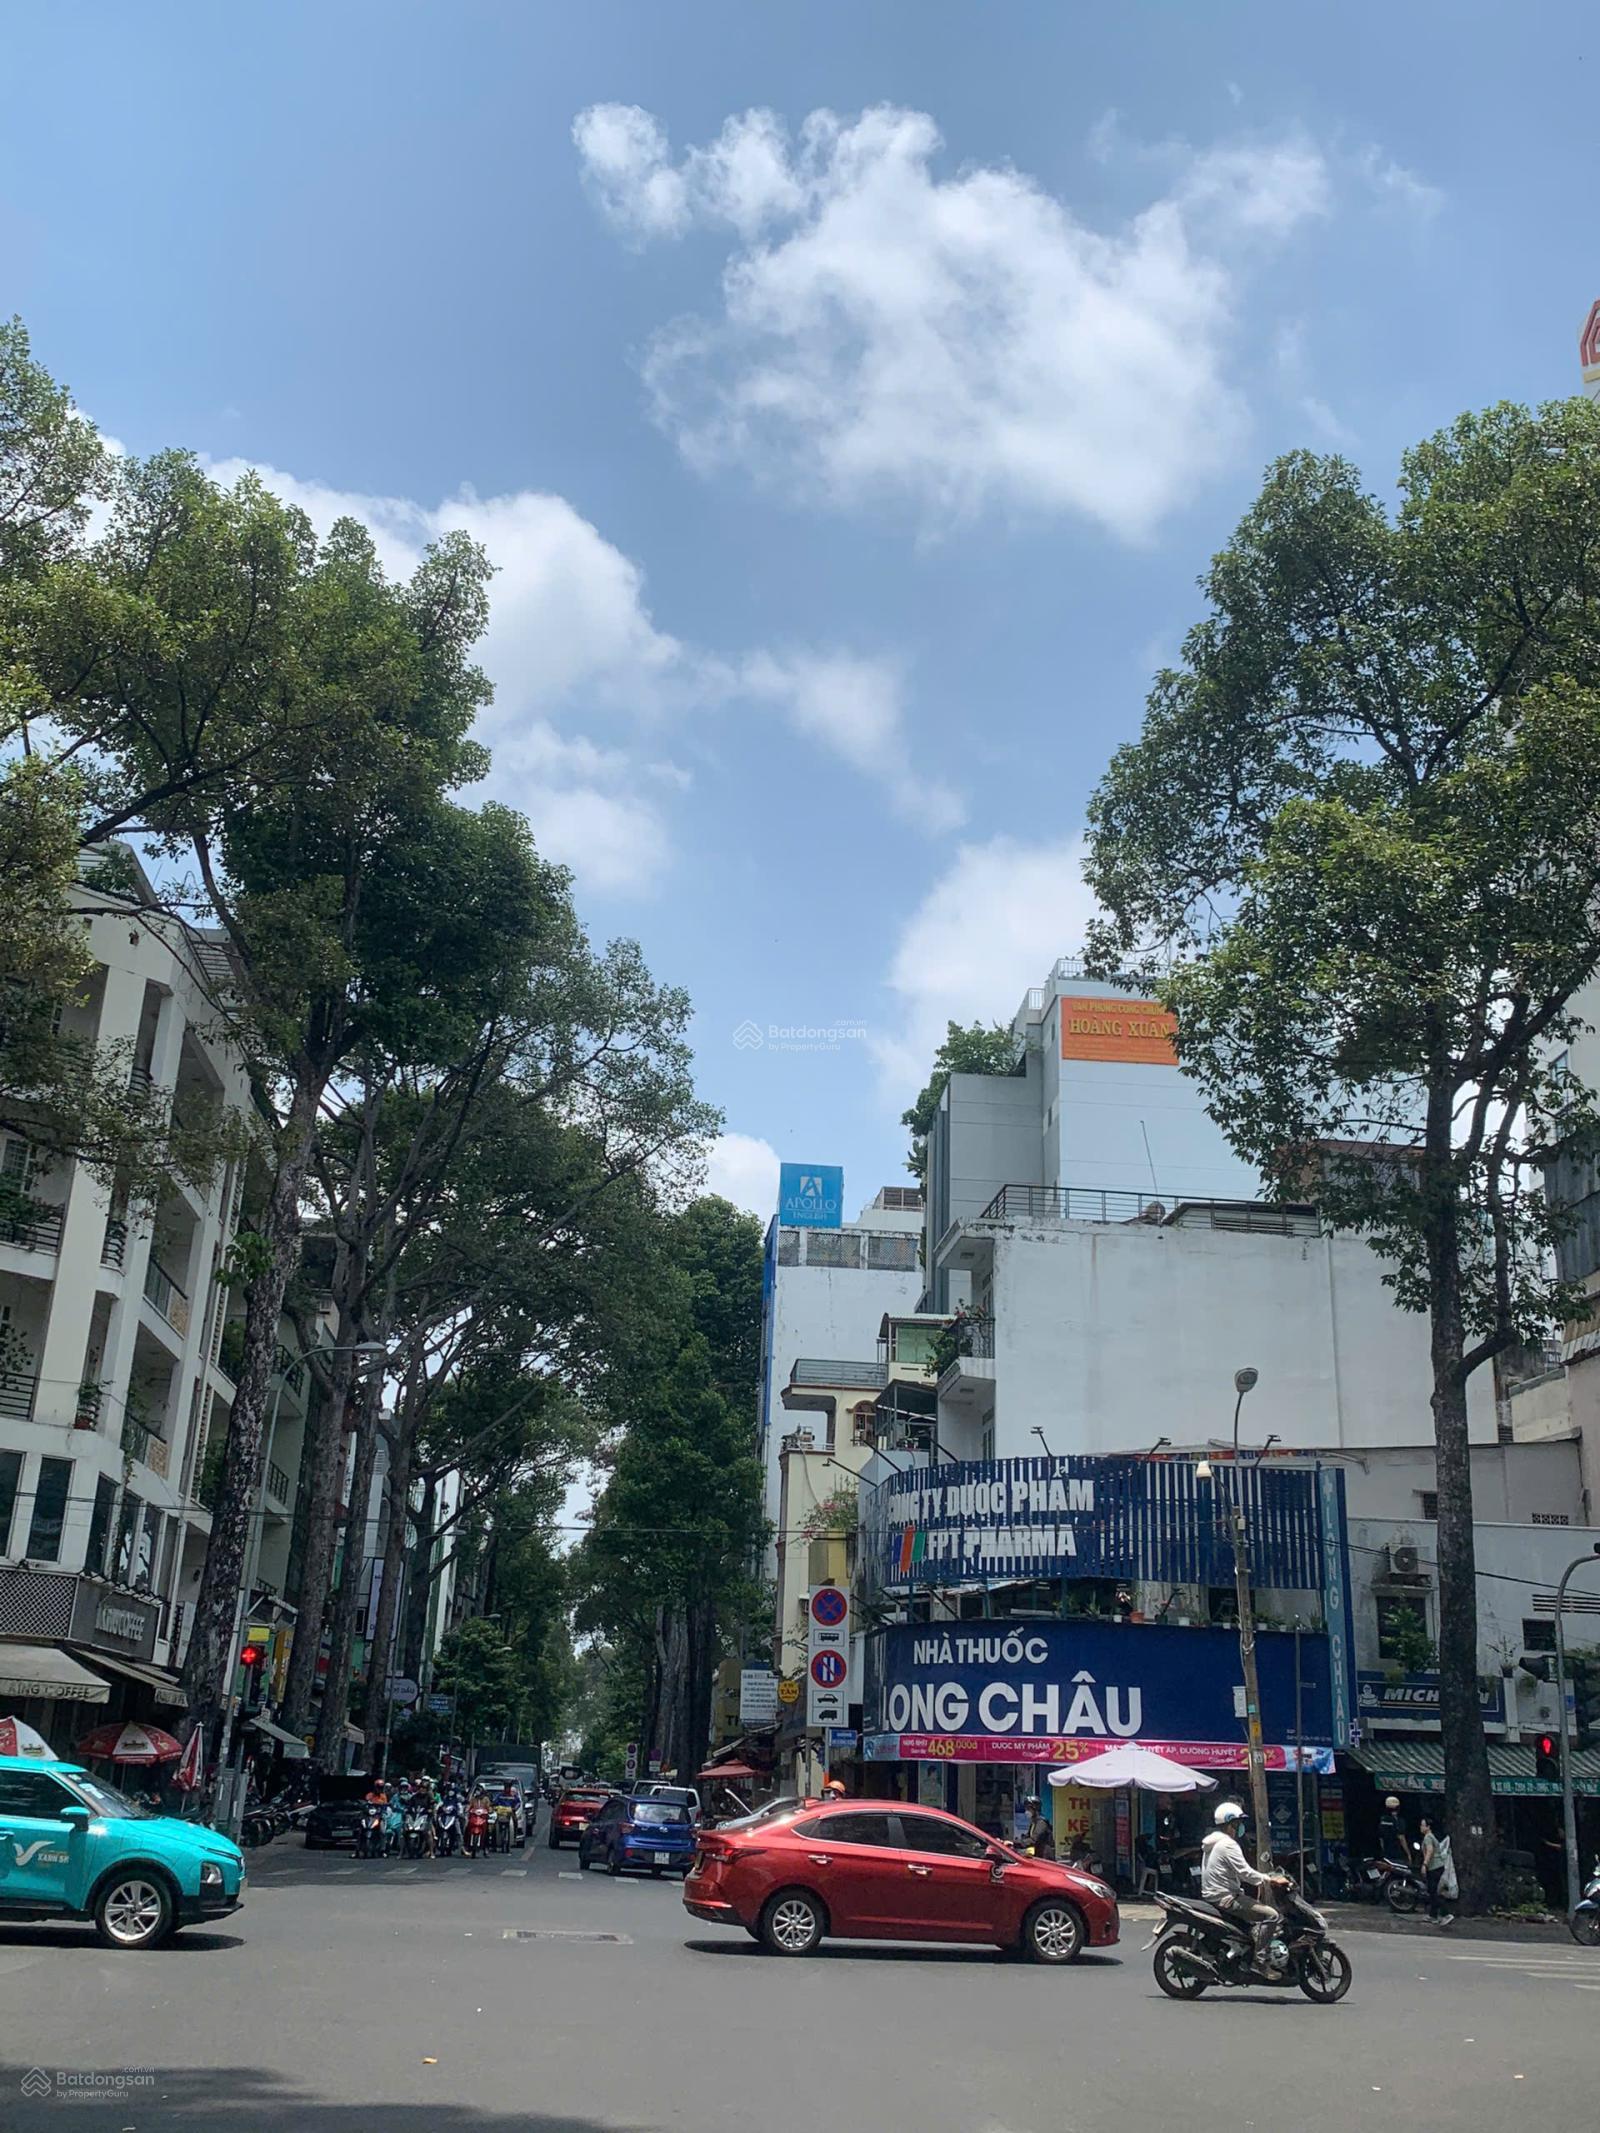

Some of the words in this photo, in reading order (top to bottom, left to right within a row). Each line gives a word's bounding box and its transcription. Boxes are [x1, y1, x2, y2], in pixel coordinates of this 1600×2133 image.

[1070, 1015, 1122, 1036] HOÀNG
[1128, 1020, 1171, 1038] XUÂN
[785, 1197, 837, 1211] APOLLO
[921, 1487, 943, 1519] TY
[1011, 1463, 1094, 1512] PHẨM
[927, 1529, 960, 1560] FPT
[963, 1524, 1078, 1559] PHARMA
[1326, 1508, 1340, 1609] LONG
[913, 1632, 954, 1664] NHÀ
[955, 1626, 1049, 1664] THUỐC
[882, 1681, 970, 1732] LONG
[978, 1670, 1142, 1737] CHÂU
[1332, 1634, 1345, 1745] CHÂU
[1052, 1740, 1089, 1760] 25%
